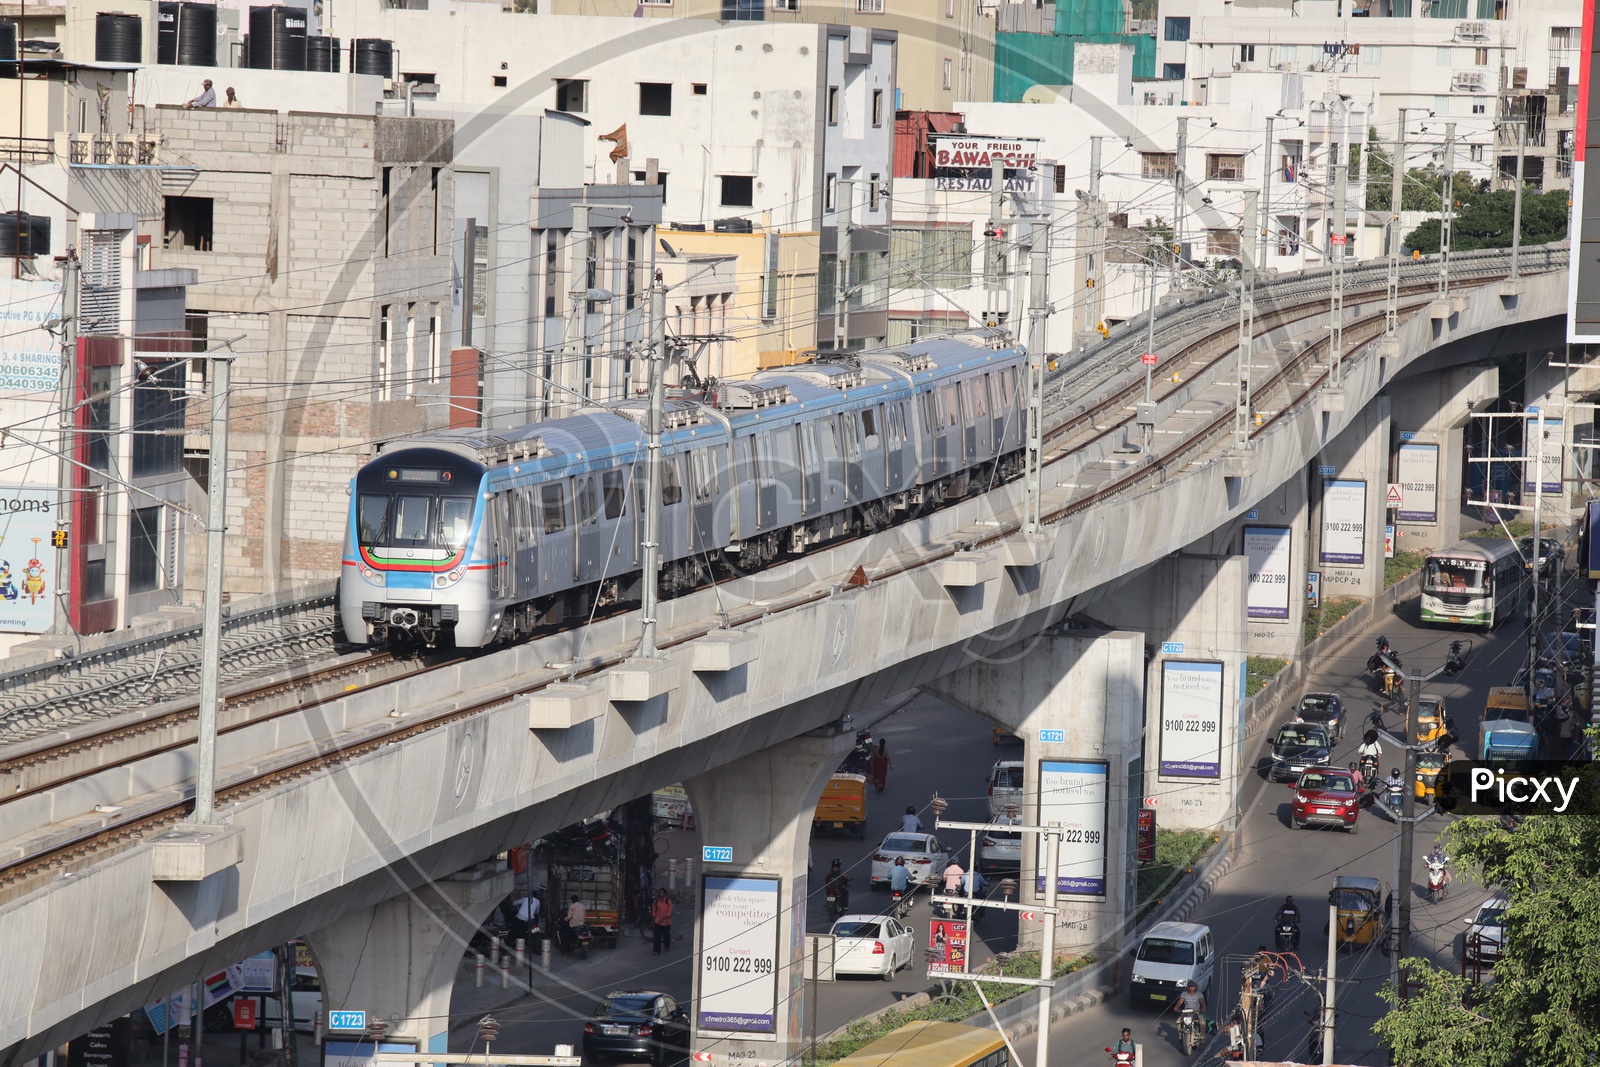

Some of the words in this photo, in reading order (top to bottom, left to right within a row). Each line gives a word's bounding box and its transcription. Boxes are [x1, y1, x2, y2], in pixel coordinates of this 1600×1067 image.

[936, 178, 1034, 192] RESTAUANT
[24, 311, 33, 320] PG
[13, 353, 17, 361] 4
[20, 353, 62, 364] SHARINGS
[1326, 522, 1339, 531] 9100
[1341, 523, 1351, 531] 222
[1352, 524, 1362, 532] 999
[55, 531, 65, 539] 29
[1248, 574, 1260, 582] 100
[1262, 574, 1272, 583] 222
[1275, 575, 1286, 584] 999
[1165, 720, 1183, 731] 9100
[1186, 720, 1199, 732] 222
[1202, 721, 1216, 732] 999
[1041, 732, 1063, 740] C1721
[1066, 830, 1082, 843] 222
[1084, 831, 1100, 844] 999
[704, 849, 730, 859] C1722
[717, 908, 772, 919] competitor
[706, 956, 730, 972] 9100
[733, 957, 751, 972] 222
[754, 958, 772, 973] 999
[332, 1014, 362, 1026] C1723
